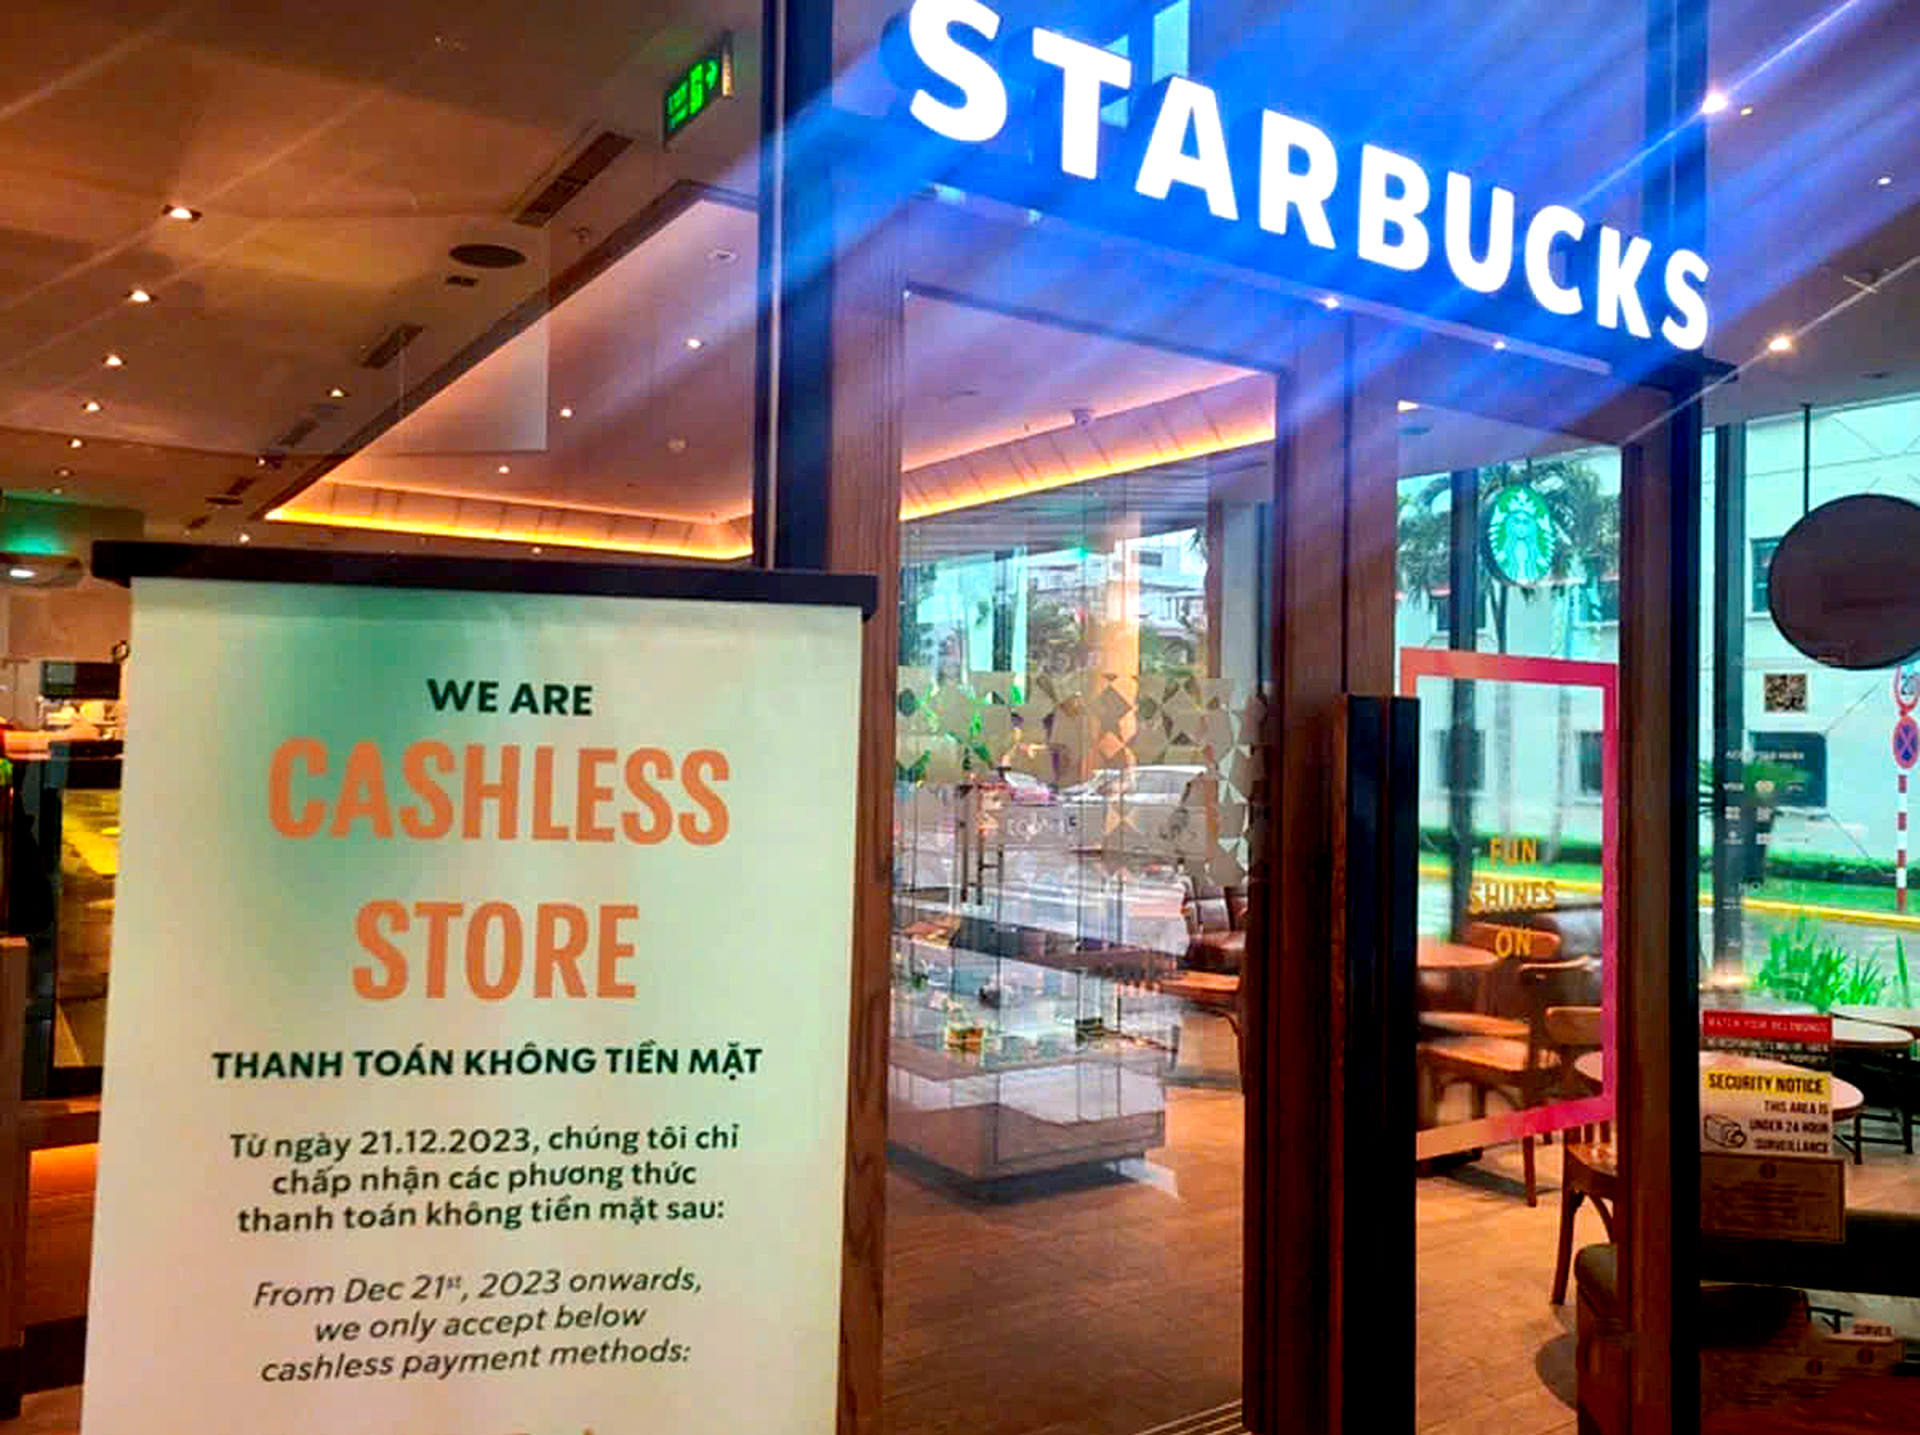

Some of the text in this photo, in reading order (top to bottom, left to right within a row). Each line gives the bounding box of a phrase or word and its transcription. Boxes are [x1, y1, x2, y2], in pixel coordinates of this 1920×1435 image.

[908, 0, 1710, 350] STARBUCKS
[427, 678, 594, 717] WE ARE
[267, 736, 731, 847] CASHLESS
[1489, 838, 1537, 866] FUN
[1469, 881, 1556, 913] SHINES
[351, 898, 640, 1001] STORE
[1494, 930, 1532, 957] ON
[212, 1040, 763, 1081] THANH TOÁN KHÔNG TIỀN MẶT
[1708, 1074, 1824, 1094] SECURITY NOTICE
[1763, 1100, 1787, 1113] THIS
[1790, 1101, 1816, 1114] AREA
[230, 1122, 740, 1161] Từ ngày 21.12.2023, chúng tôi chỉ
[272, 1160, 698, 1196] chấp nhận các phương thức
[237, 1193, 726, 1233] thanh toán không tiền mặt sau:
[253, 1281, 335, 1308] From
[343, 1278, 403, 1304] Dec
[478, 1270, 560, 1299] 2023
[568, 1266, 703, 1294] onwards,
[314, 1304, 648, 1343] we only accept below
[260, 1338, 691, 1383] cashless payment methods:
